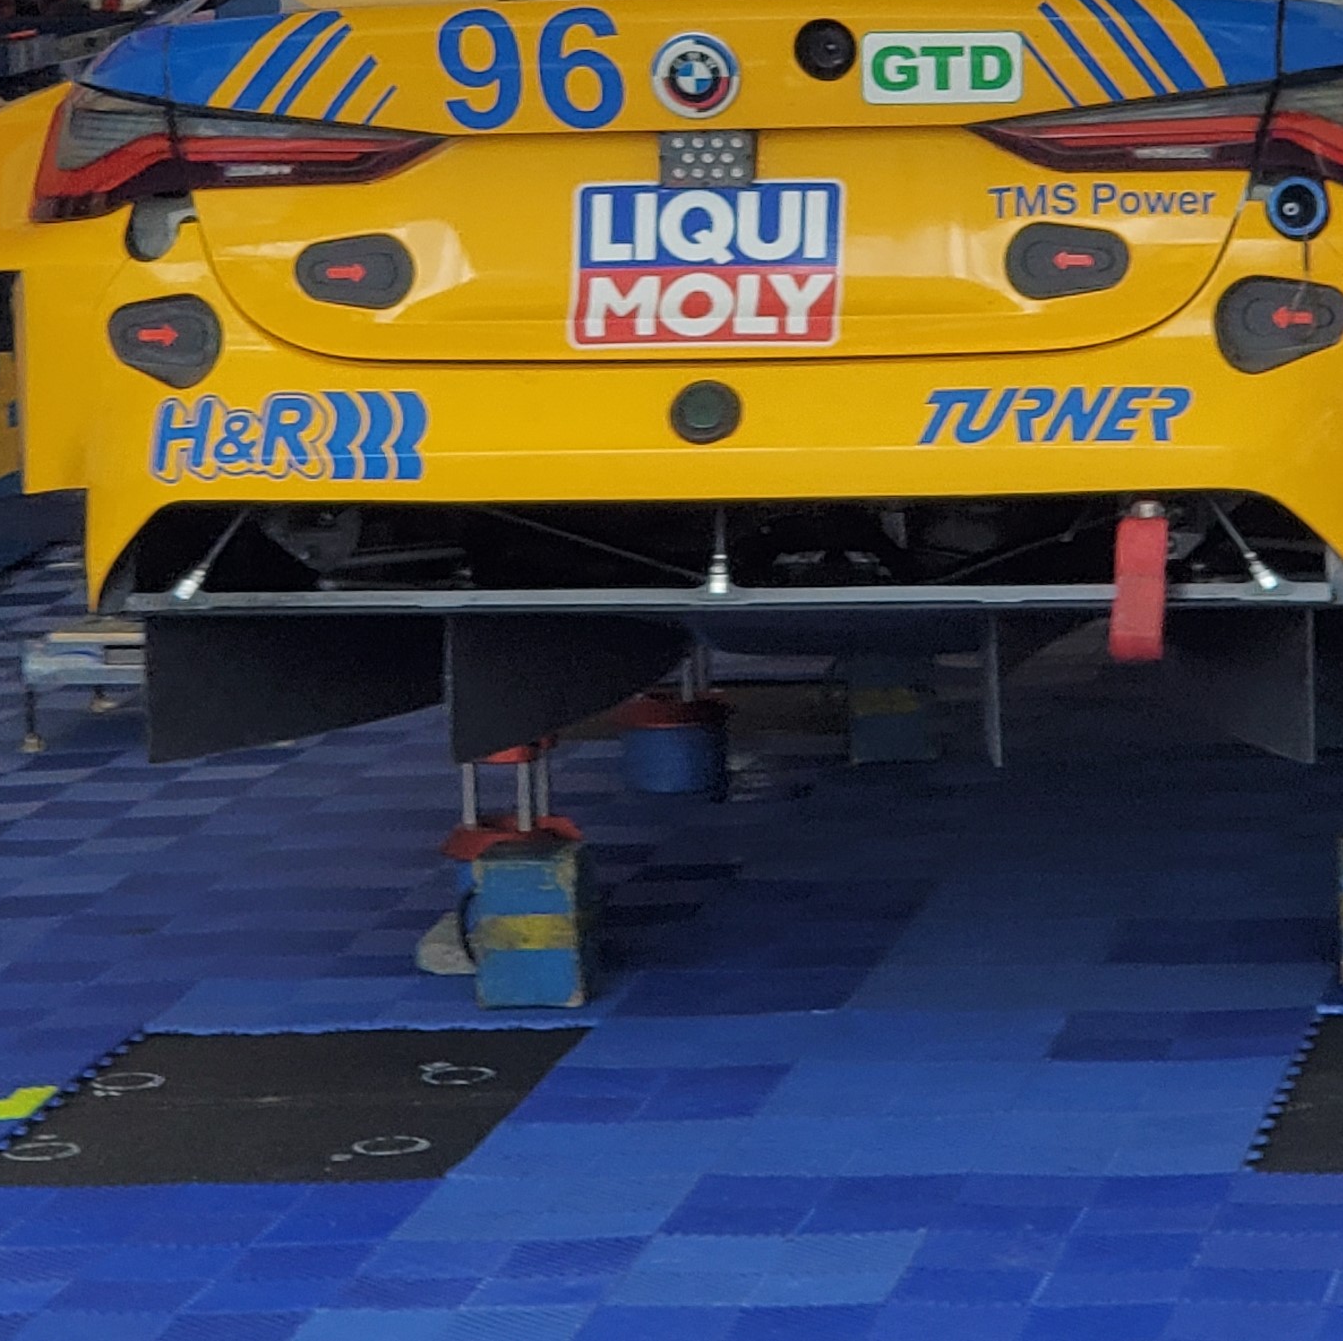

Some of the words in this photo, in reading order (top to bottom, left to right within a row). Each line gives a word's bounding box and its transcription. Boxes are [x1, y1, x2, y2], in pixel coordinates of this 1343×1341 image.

[437, 7, 626, 131] 96
[871, 45, 1014, 92] GTD
[591, 189, 830, 265] LIQUI
[988, 183, 1079, 220] TMS
[1091, 182, 1216, 216] Power
[584, 271, 833, 338] MOLY
[150, 391, 328, 484] H&R
[918, 384, 1194, 446] TURNER
